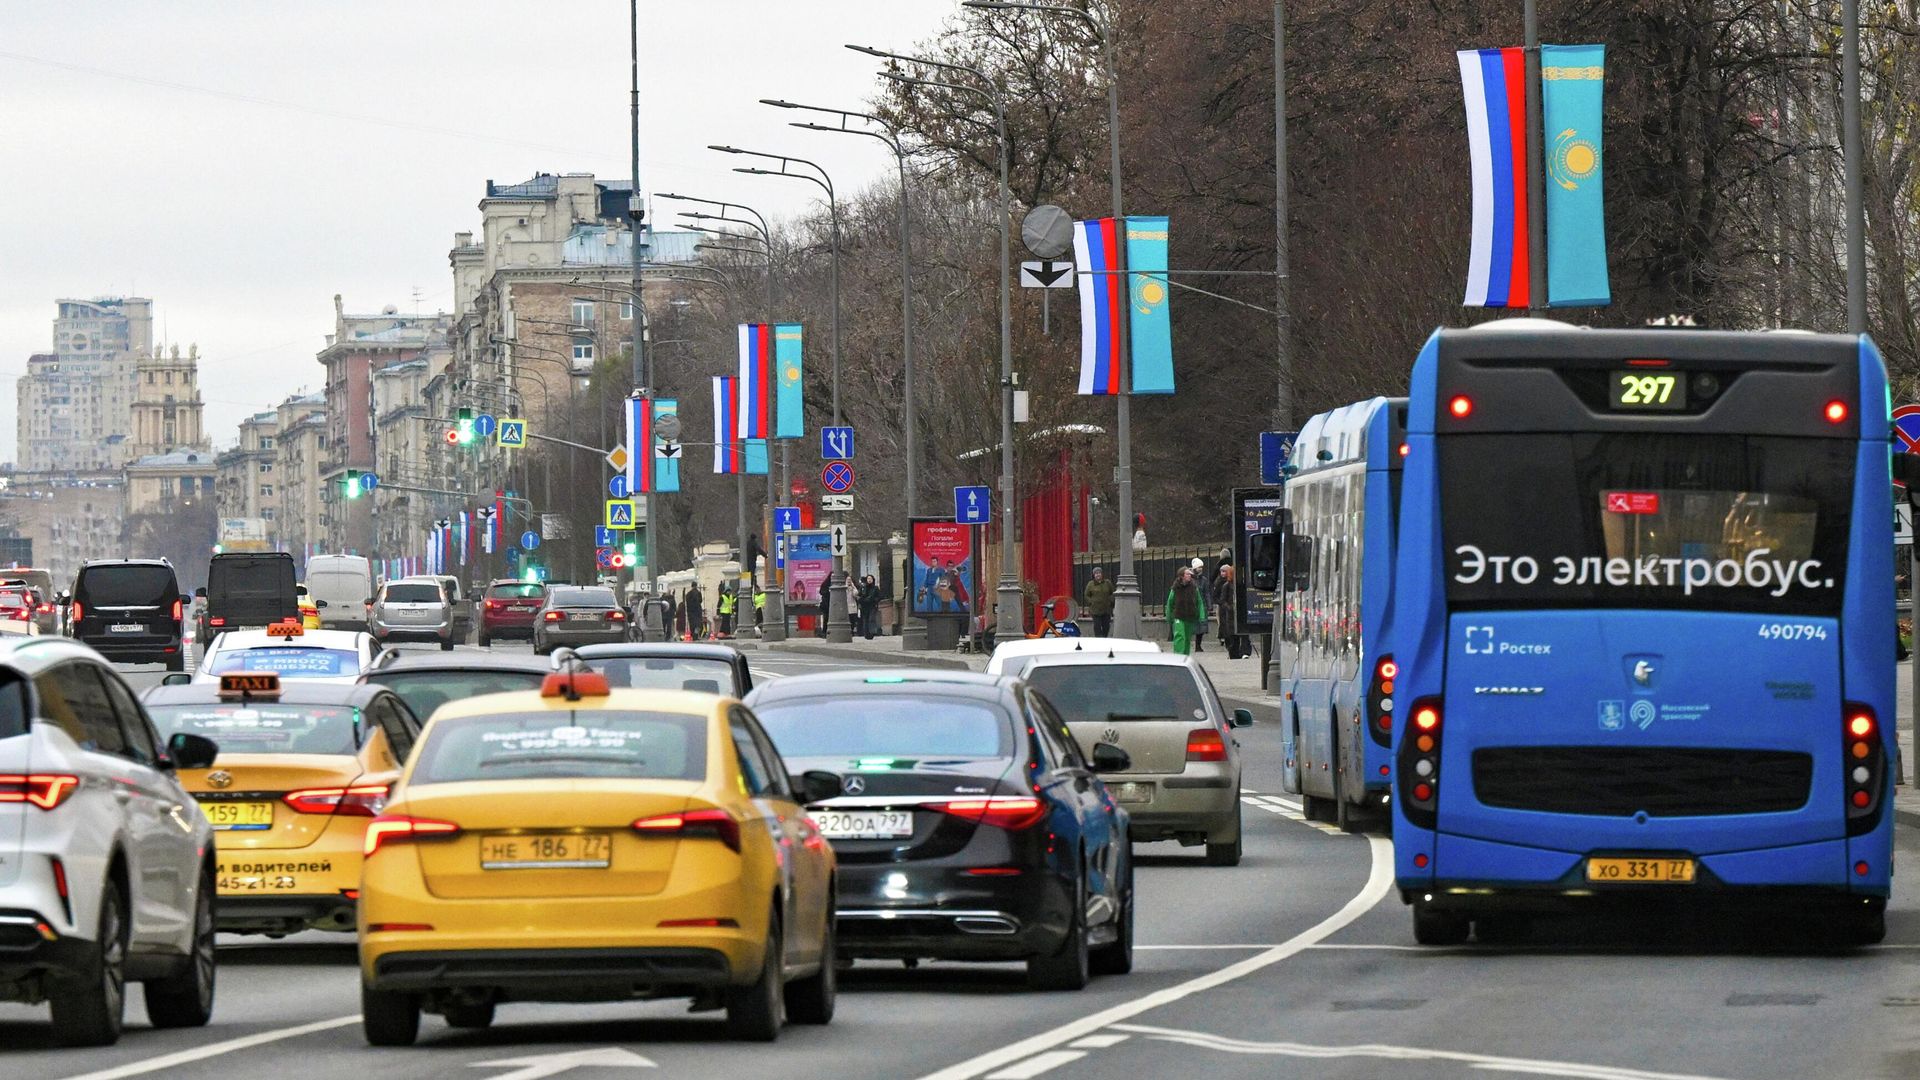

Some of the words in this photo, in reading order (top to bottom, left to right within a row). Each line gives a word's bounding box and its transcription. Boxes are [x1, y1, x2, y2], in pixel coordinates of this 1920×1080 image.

[1620, 376, 1675, 404] 297
[1454, 545, 1539, 585] Это
[1553, 548, 1834, 597] электробус.
[640, 583, 664, 591] СТП
[1758, 624, 1827, 641] 490794
[1500, 642, 1551, 654] Ростех
[227, 678, 271, 690] TAXI
[208, 806, 238, 822] 159
[250, 804, 266, 817] 77
[880, 814, 908, 827] 797
[492, 844, 517, 858] НЕ
[531, 838, 568, 858] 186
[583, 836, 601, 850] 77
[231, 860, 332, 874] водителей
[1598, 865, 1619, 878] ХО
[1627, 862, 1658, 878] 331
[1670, 862, 1686, 873] 77
